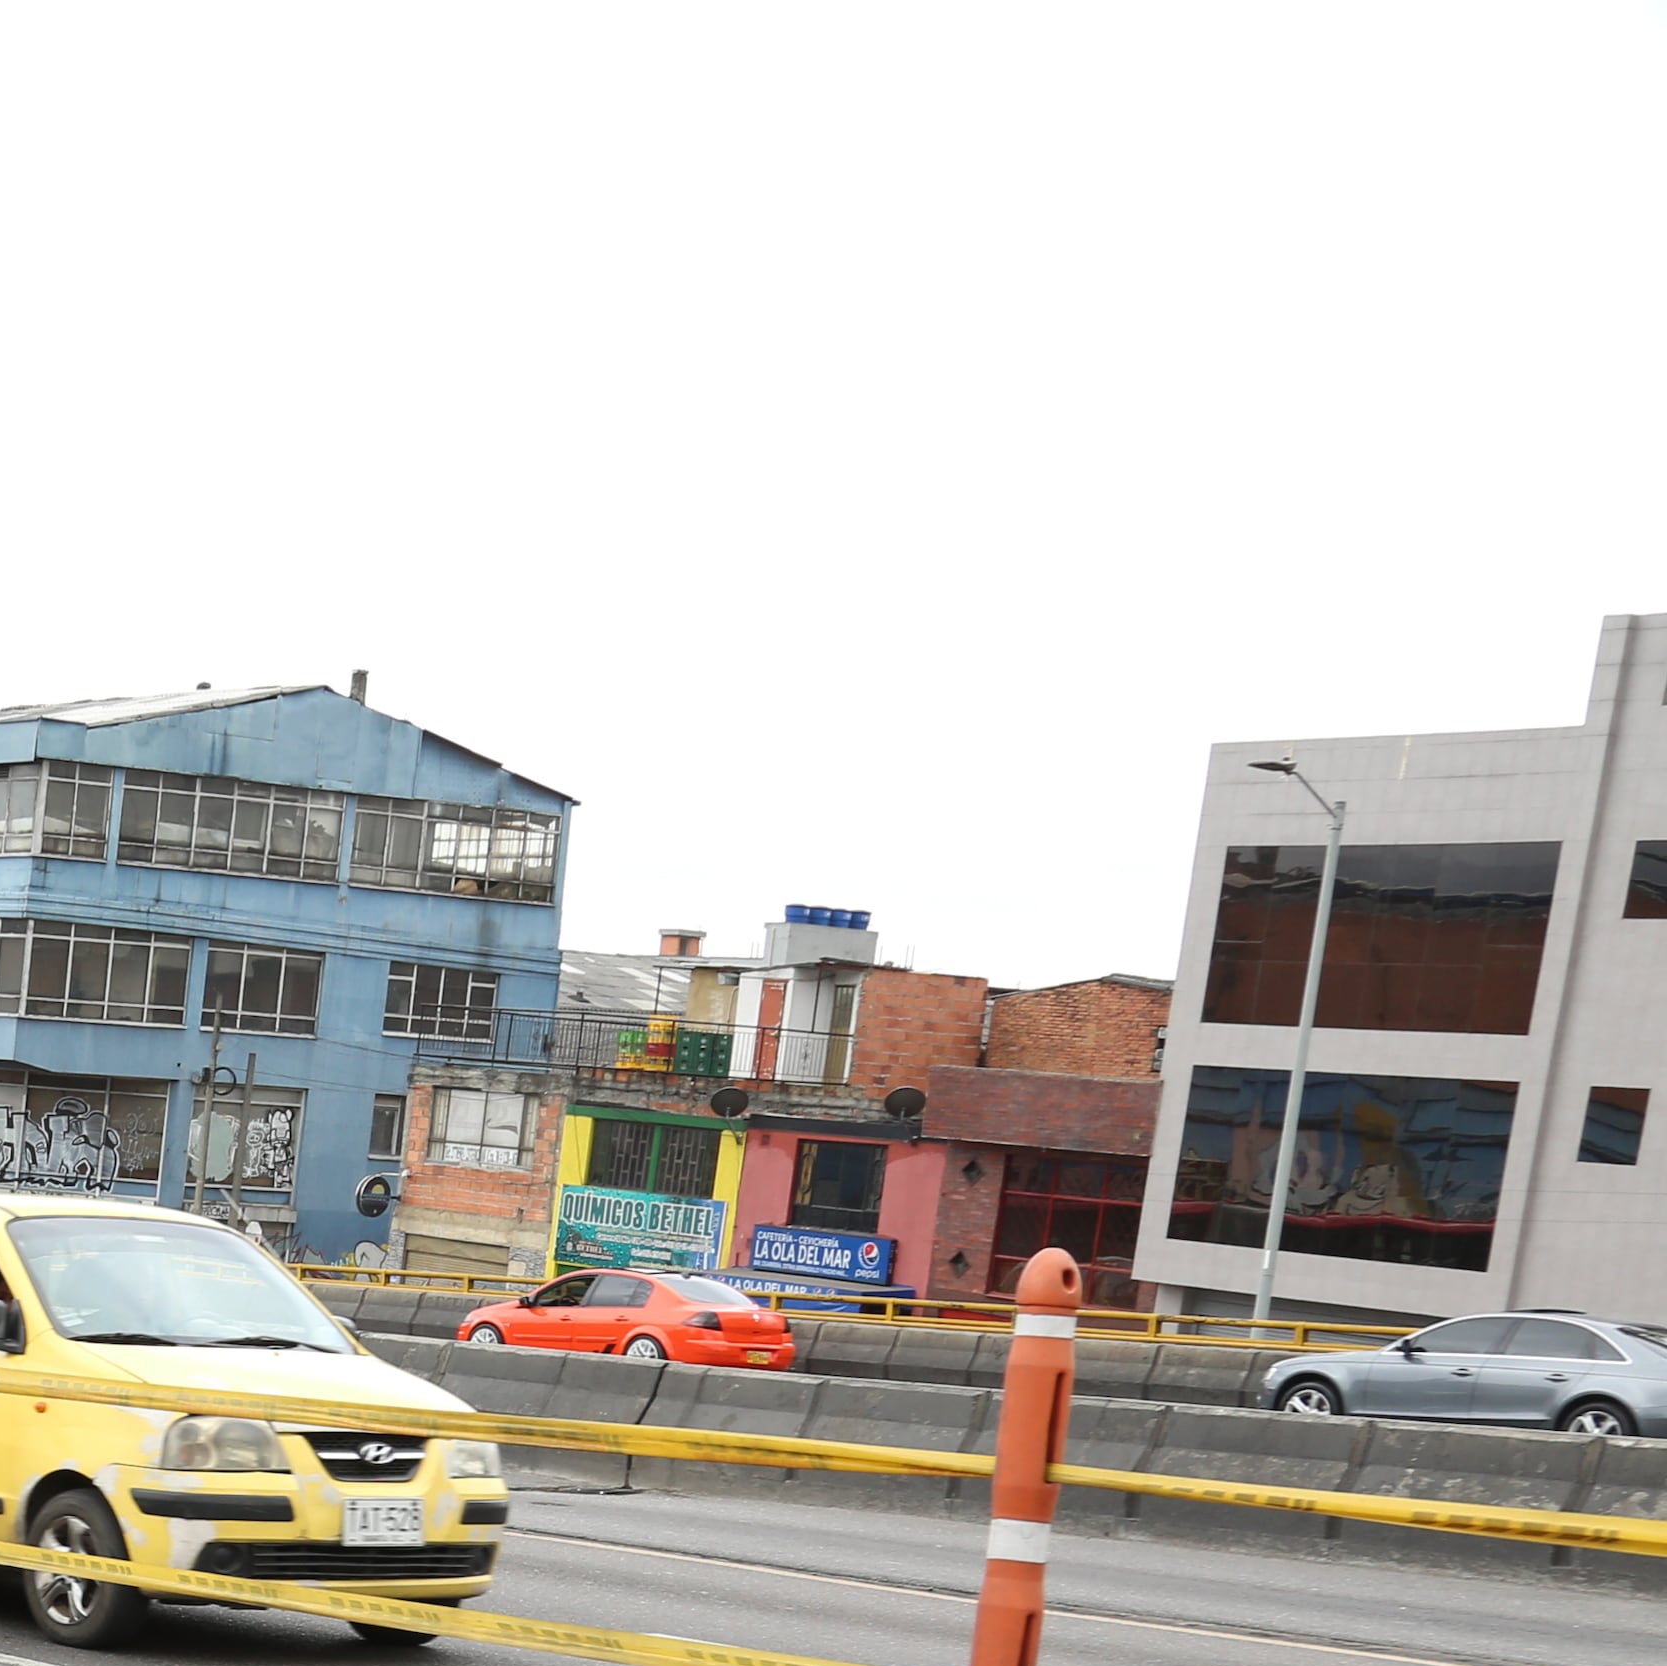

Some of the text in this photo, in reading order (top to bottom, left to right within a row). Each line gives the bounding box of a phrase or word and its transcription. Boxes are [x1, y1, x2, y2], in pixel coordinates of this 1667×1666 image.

[562, 1190, 714, 1239] QUÍMICOS BETHEL
[757, 1230, 839, 1248] CAFETERÍA CEVICHERÍA
[755, 1240, 769, 1260] LA
[771, 1243, 796, 1263] OLA
[797, 1246, 820, 1266] DEL
[822, 1249, 852, 1270] MAR
[854, 1268, 880, 1280] pepsi
[743, 1279, 762, 1290] OLA
[764, 1281, 781, 1292] DEL
[785, 1283, 807, 1294] MAR
